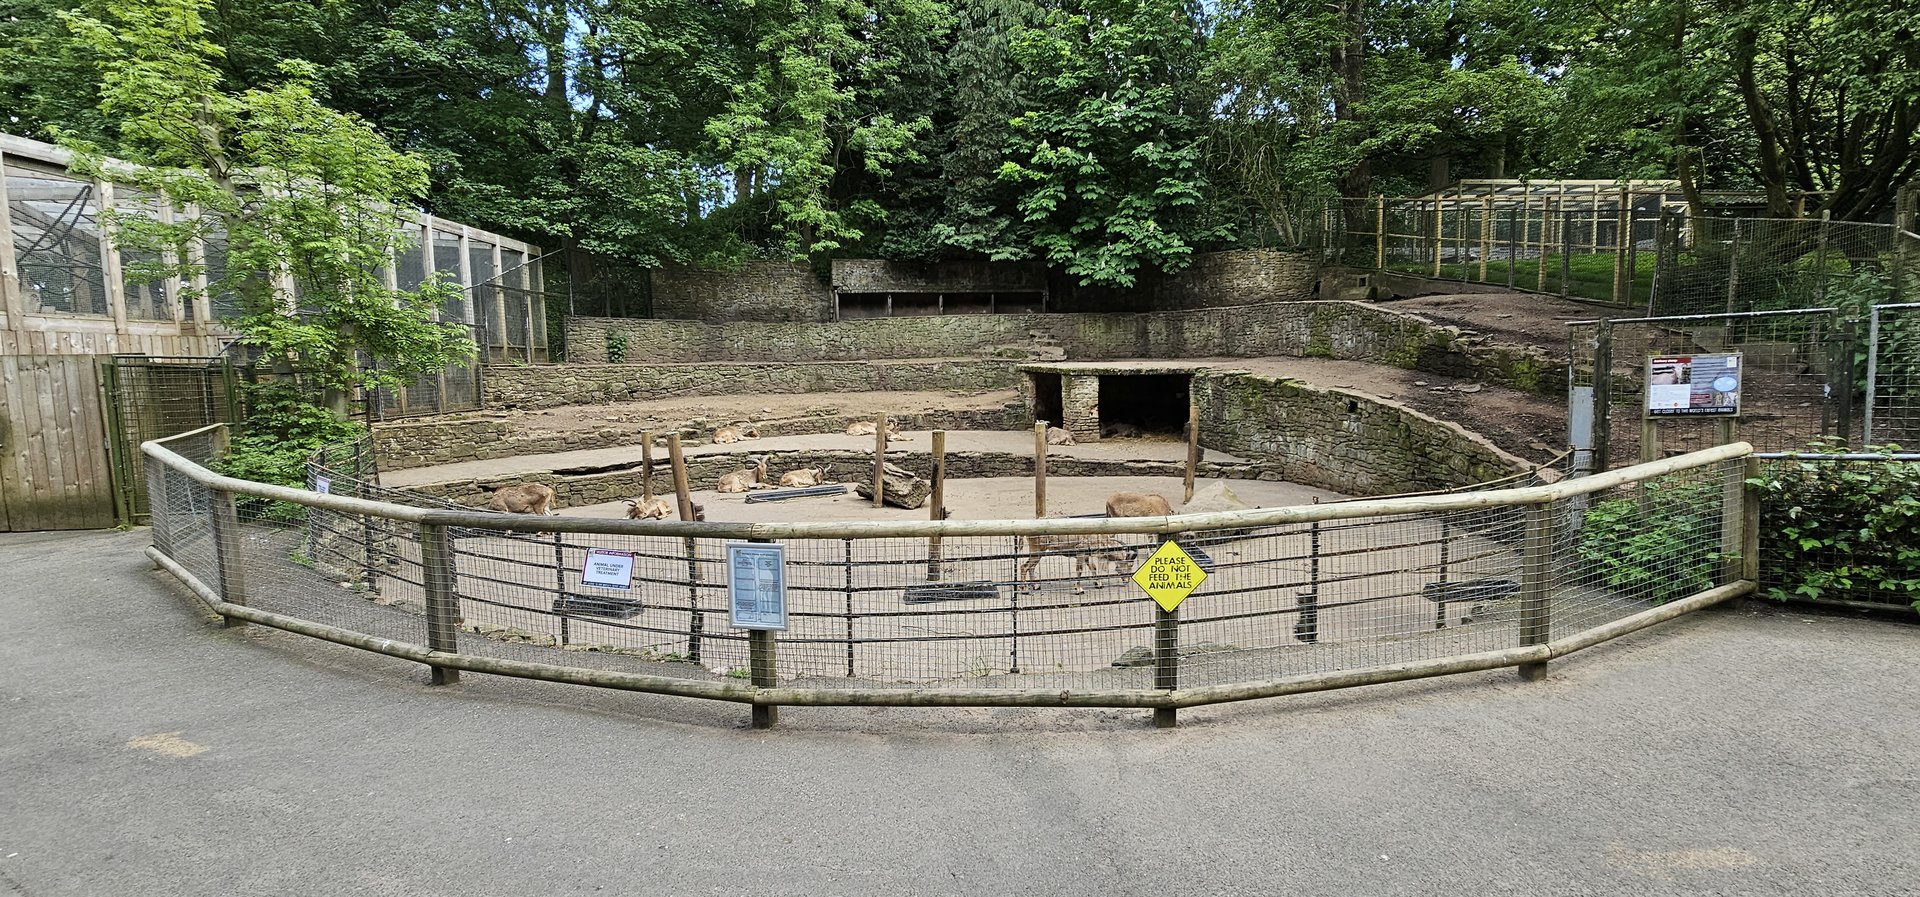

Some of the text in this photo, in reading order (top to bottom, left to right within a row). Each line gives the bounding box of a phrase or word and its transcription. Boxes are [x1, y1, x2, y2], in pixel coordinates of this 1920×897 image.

[1155, 557, 1185, 565] PLEASE
[1151, 565, 1165, 573] DO
[1149, 573, 1191, 581] FEED THE
